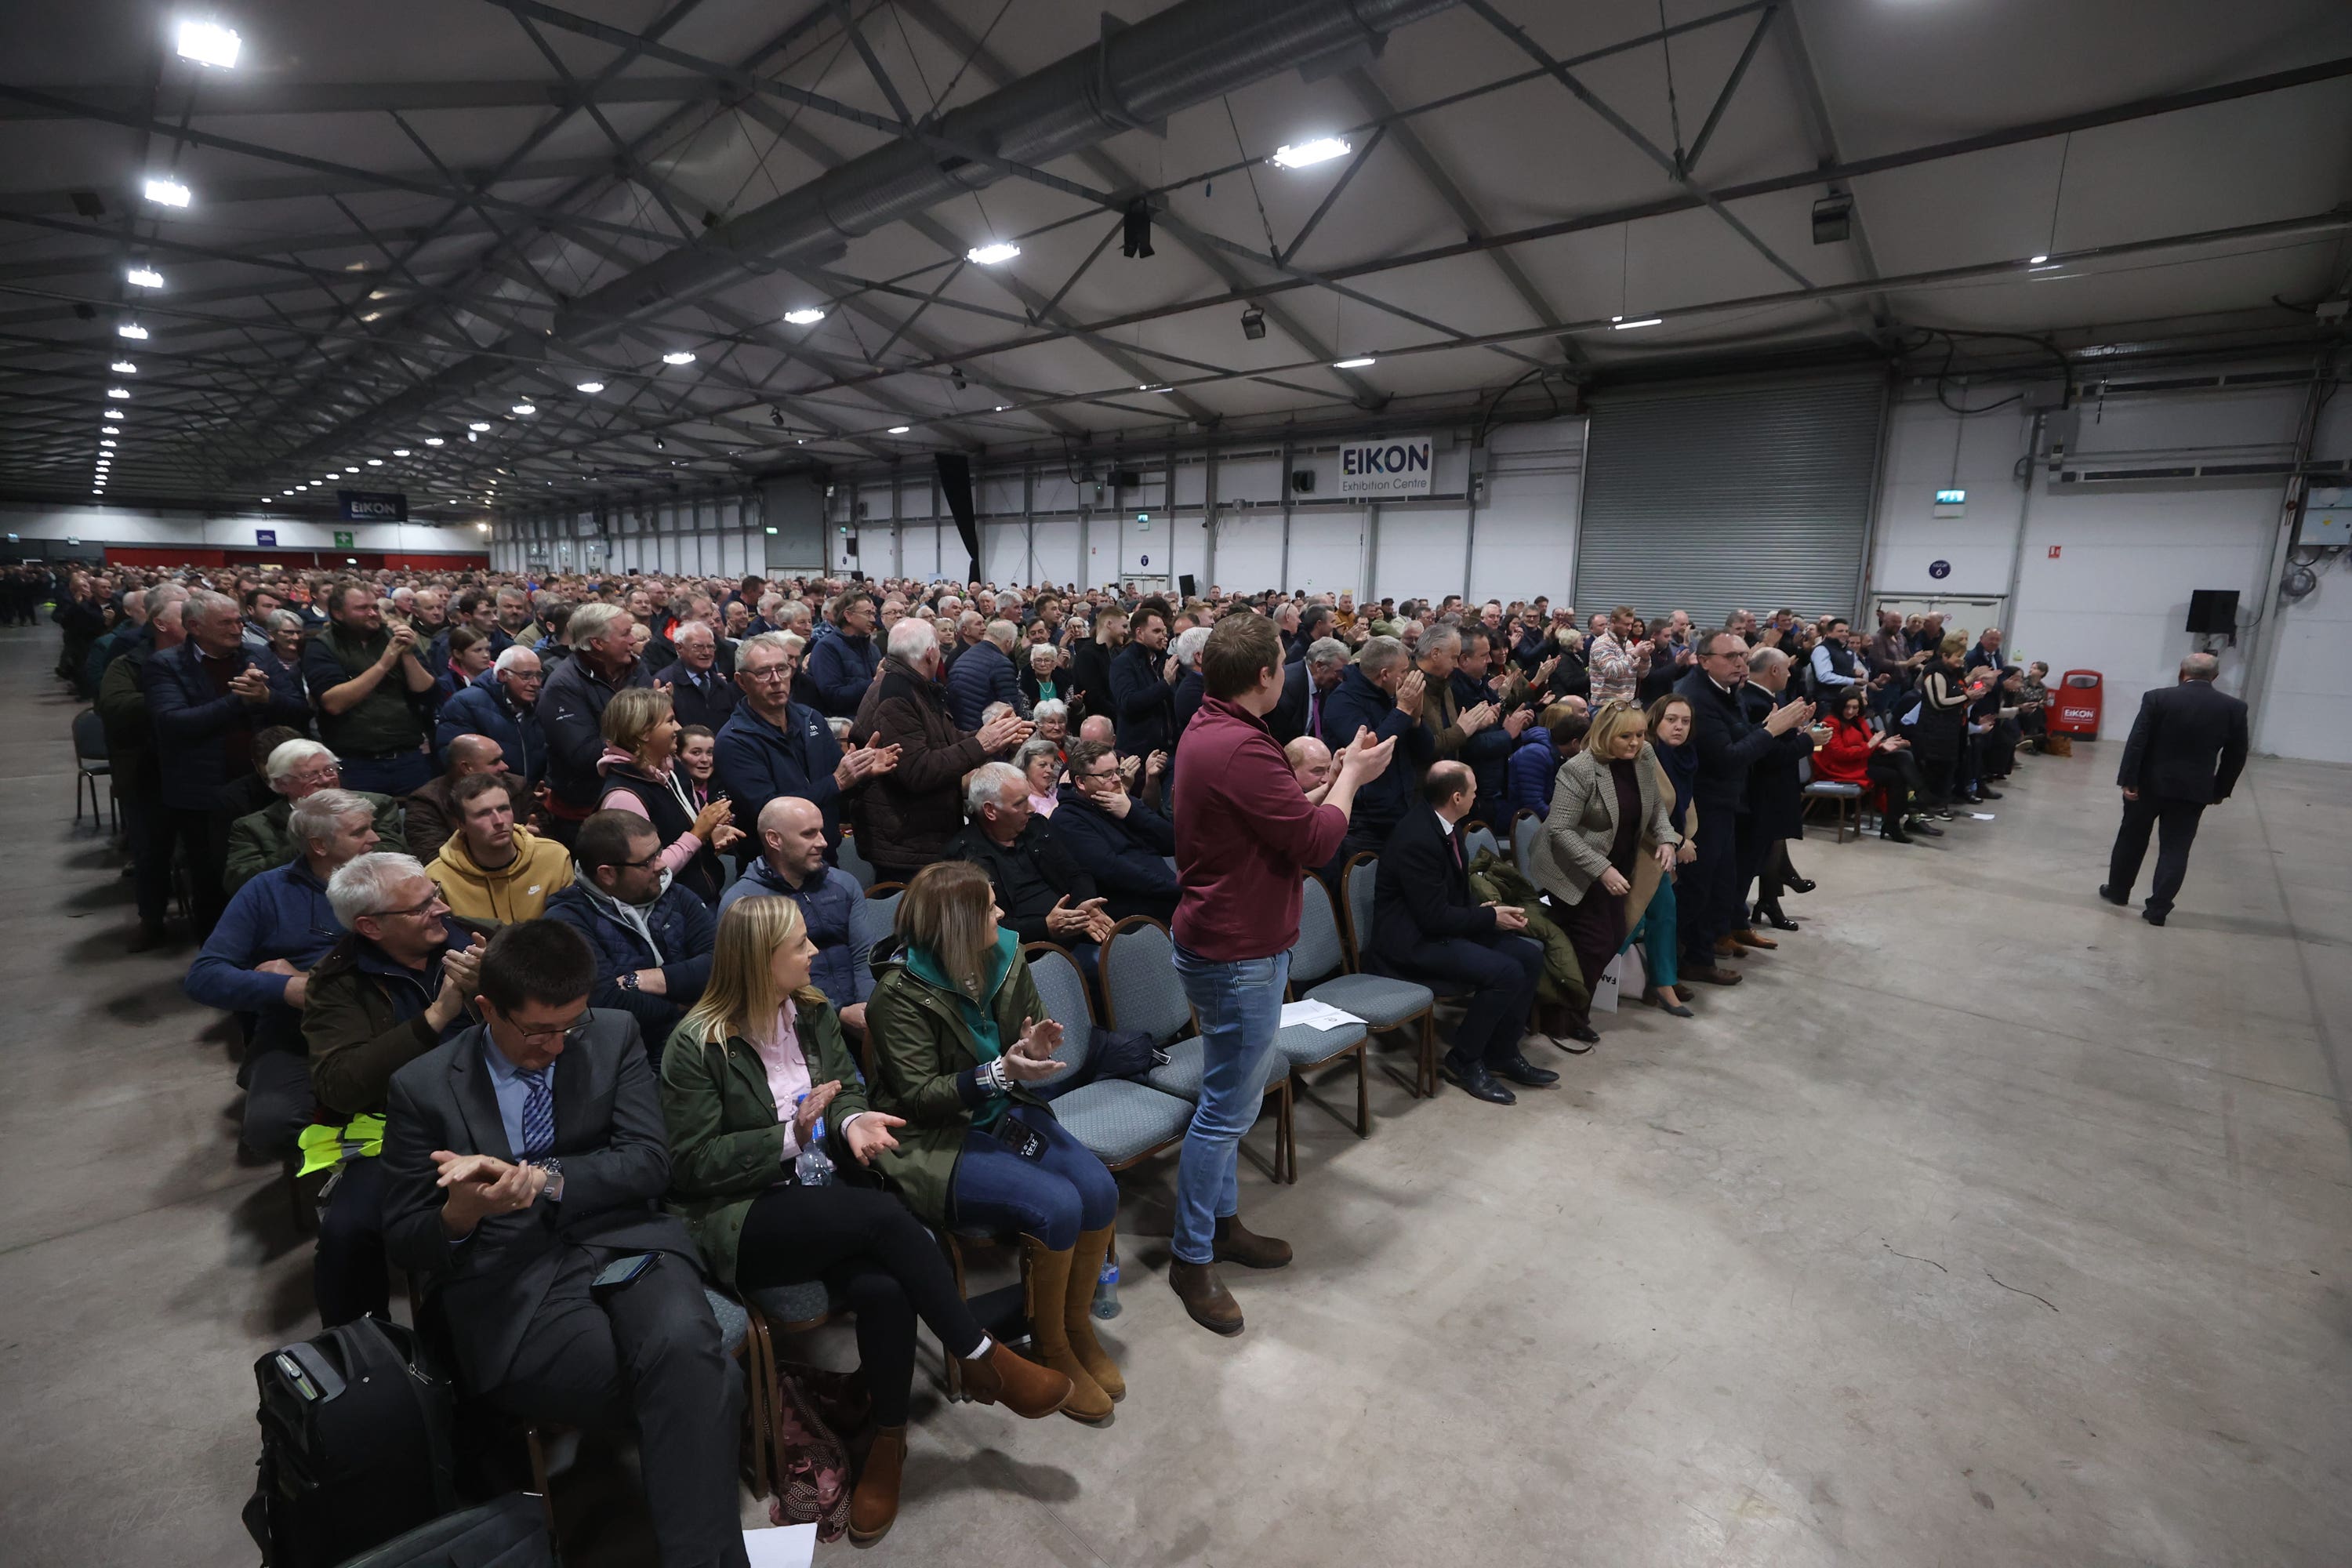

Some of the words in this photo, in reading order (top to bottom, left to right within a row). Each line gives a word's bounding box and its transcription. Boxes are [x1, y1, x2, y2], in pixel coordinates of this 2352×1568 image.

[1343, 443, 1429, 475] EIKON
[1342, 481, 1390, 492] Exhibition
[1392, 478, 1427, 489] Centre
[350, 501, 397, 514] EIKON
[1936, 568, 1943, 576] 6
[2064, 709, 2094, 718] EIKON
